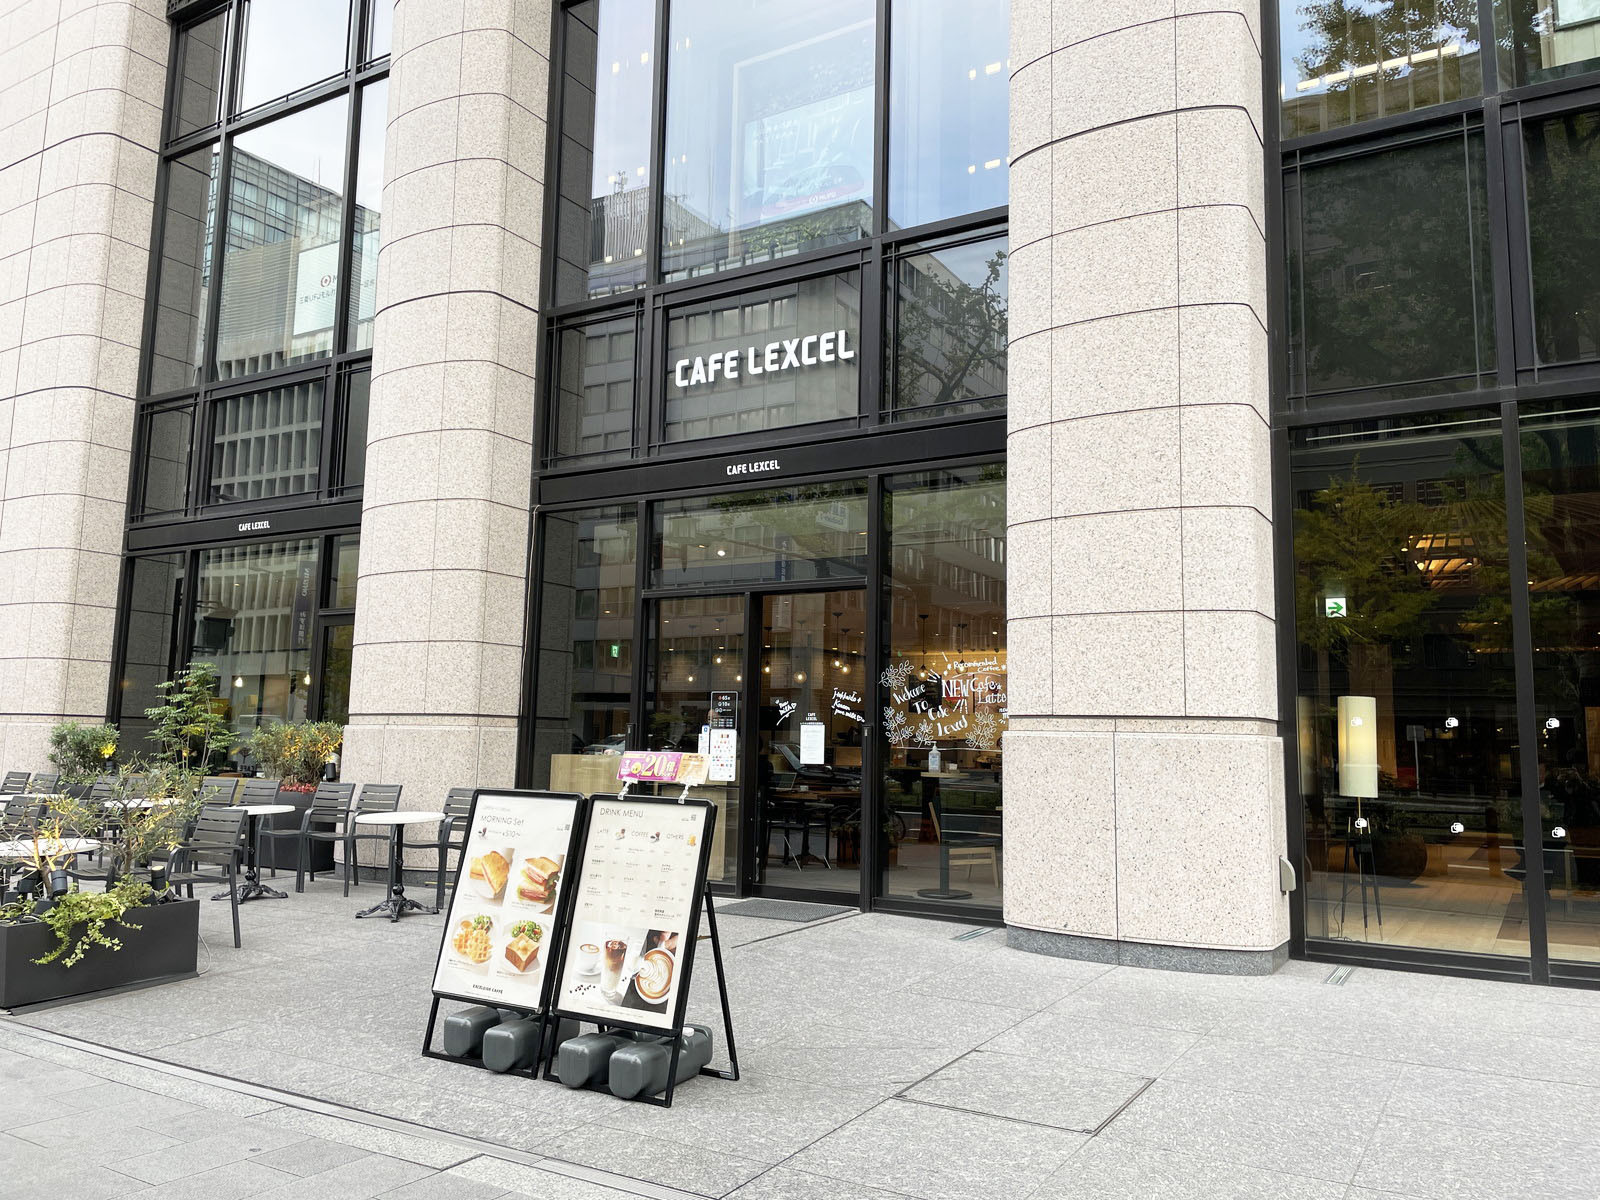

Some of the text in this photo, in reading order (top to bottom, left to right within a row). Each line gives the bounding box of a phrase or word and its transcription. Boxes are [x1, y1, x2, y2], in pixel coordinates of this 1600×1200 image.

[675, 330, 854, 387] CAFE LEXCEL
[726, 459, 780, 476] CAFE LEXCEL
[238, 520, 270, 532] CAFE LEXCEL
[942, 680, 970, 698] NEW
[978, 690, 1006, 704] Latte
[480, 816, 513, 824] MORNING
[600, 808, 644, 818] DRINK MENU
